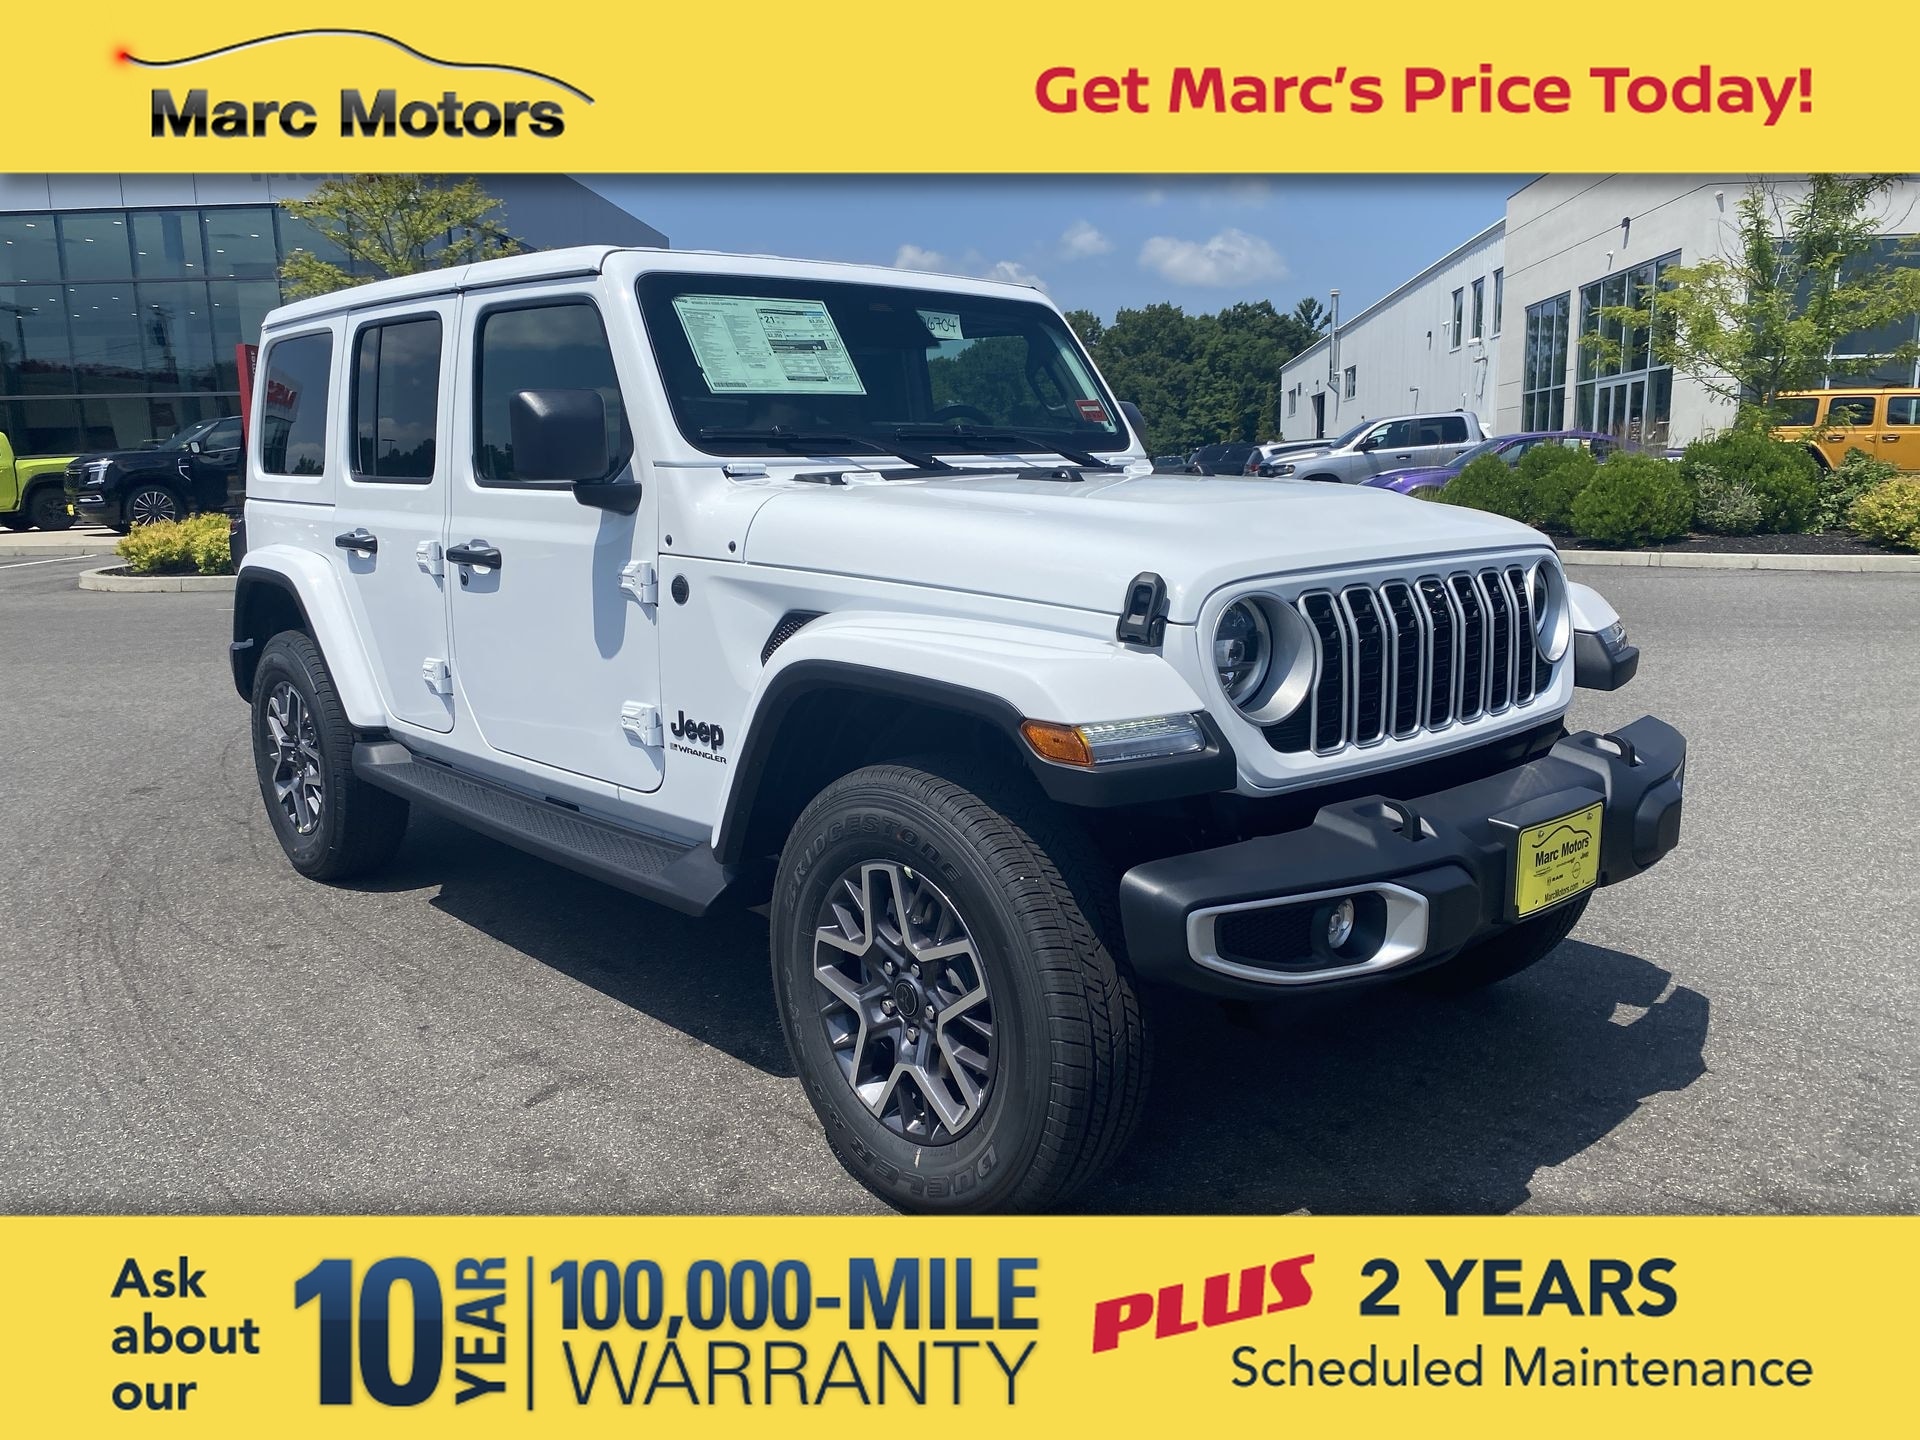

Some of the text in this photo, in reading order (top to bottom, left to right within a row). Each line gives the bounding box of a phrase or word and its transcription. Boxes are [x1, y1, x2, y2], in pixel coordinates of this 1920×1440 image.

[764, 316, 775, 324] 21
[670, 710, 724, 751] Jeep
[678, 745, 727, 764] WRANGLER
[785, 813, 962, 911] BRIDGESTONE
[1535, 850, 1559, 867] Marc
[1561, 837, 1589, 857] Motors
[1544, 882, 1579, 903] MarcMotors.com
[849, 1136, 998, 1199] DUELER
